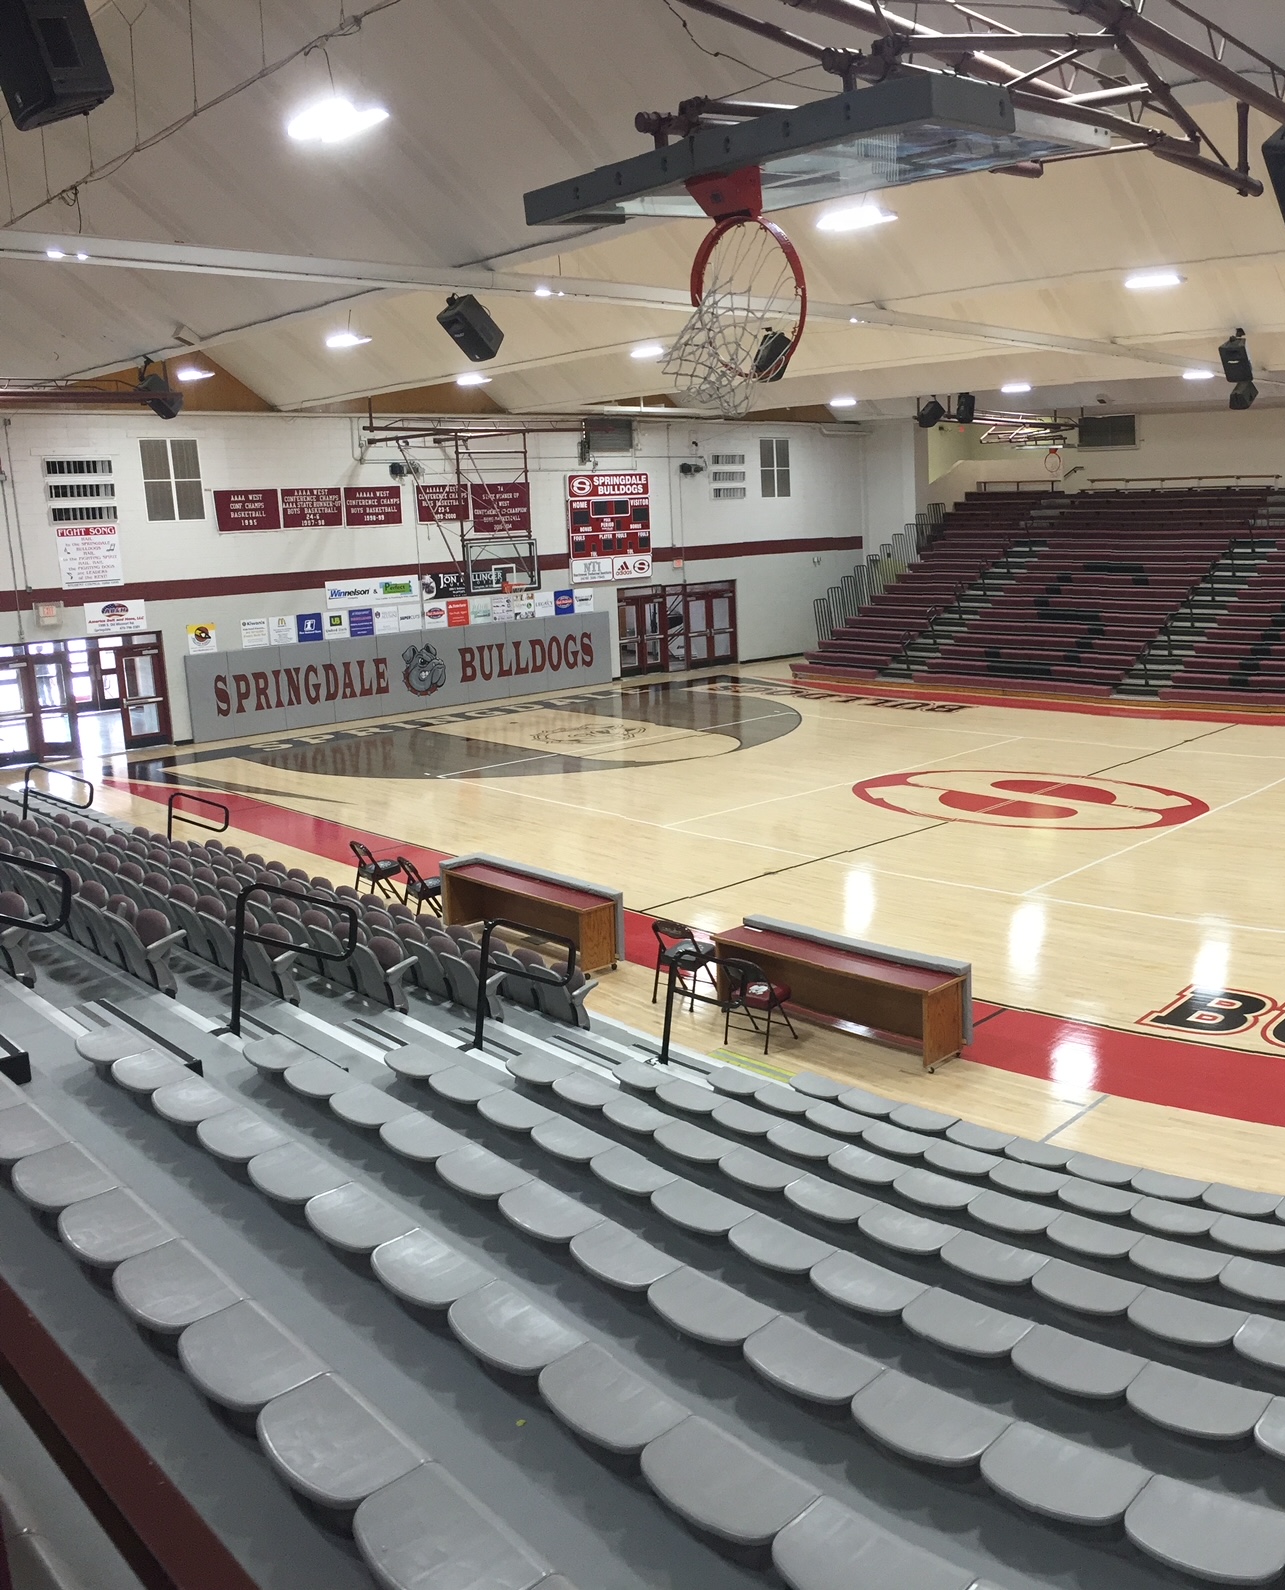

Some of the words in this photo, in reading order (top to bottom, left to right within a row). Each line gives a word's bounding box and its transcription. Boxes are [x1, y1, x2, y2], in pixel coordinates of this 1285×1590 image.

[593, 476, 647, 486] SPRINGDALE
[598, 484, 644, 494] BULLDOGS
[630, 498, 649, 506] VISITOR
[230, 510, 266, 518] BASKETBALL
[58, 528, 86, 537] FIGHT
[89, 526, 115, 535] SONG
[384, 582, 406, 591] Perfect
[330, 588, 370, 598] Winnelson
[214, 657, 390, 718] SPRINGDALE
[458, 632, 595, 684] BULLDOGS
